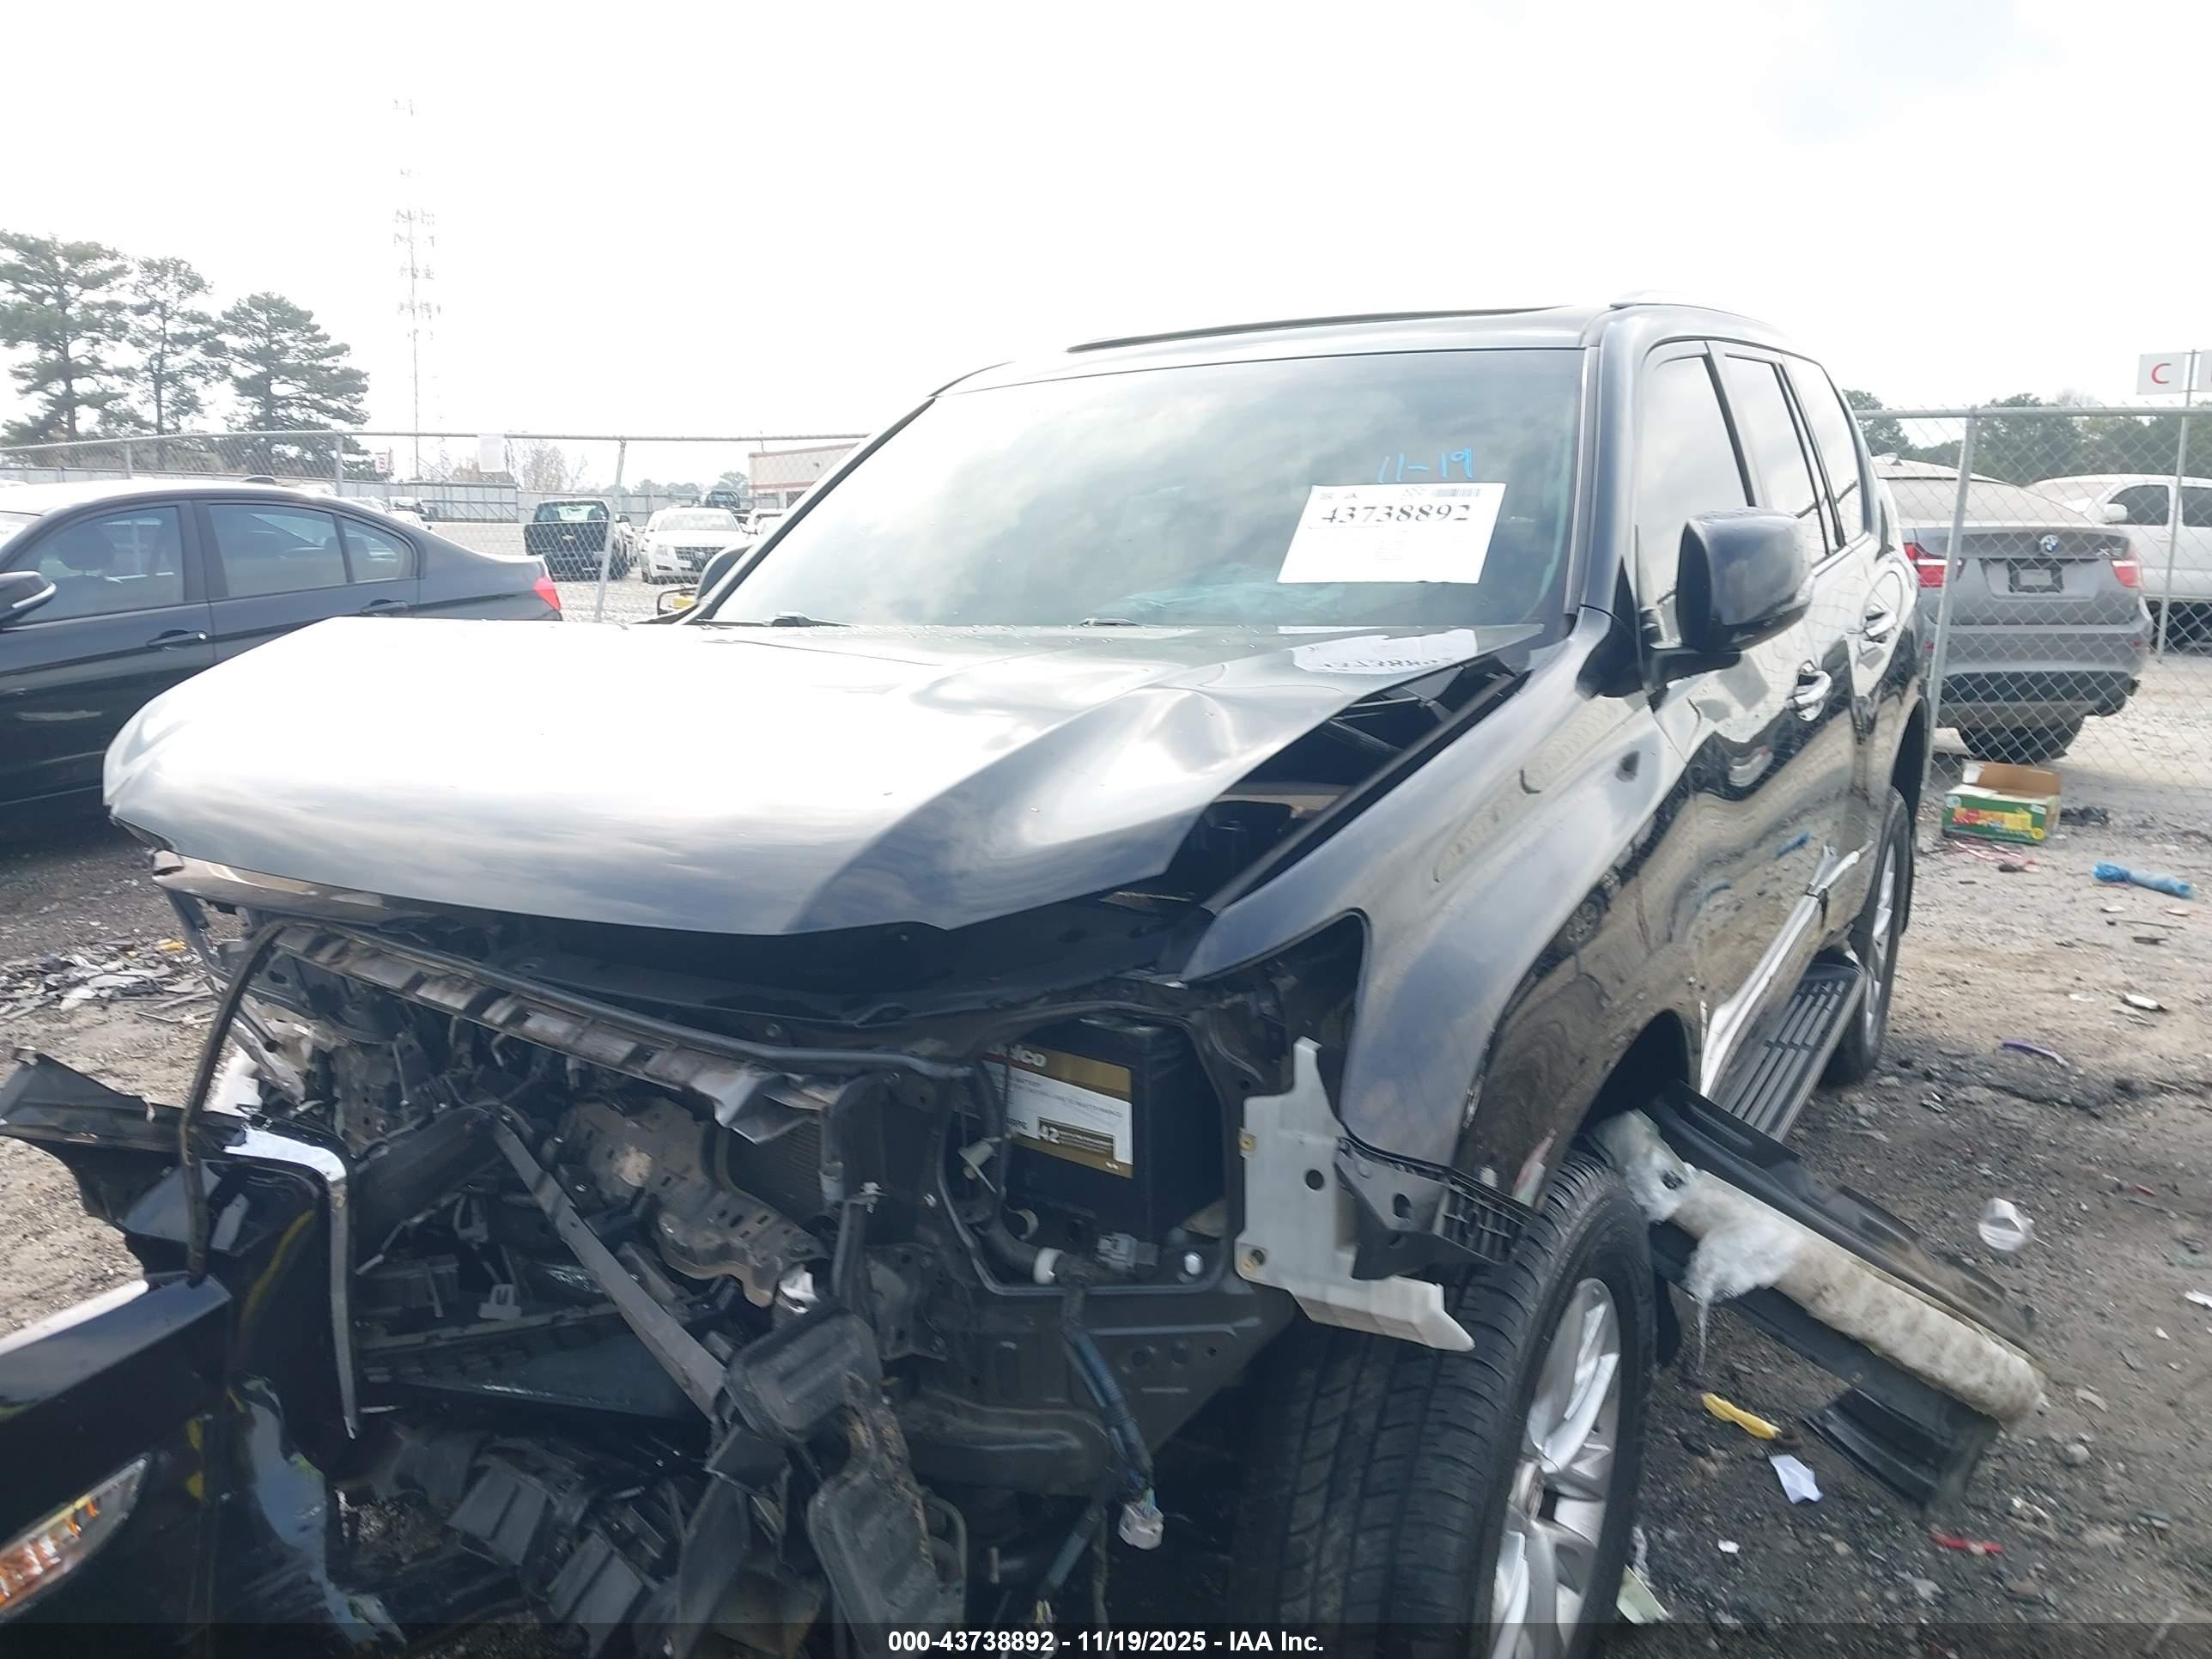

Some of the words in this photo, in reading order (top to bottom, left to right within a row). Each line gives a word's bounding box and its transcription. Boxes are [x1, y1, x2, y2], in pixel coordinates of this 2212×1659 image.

[2151, 362, 2171, 384] C
[1378, 448, 1473, 483] 11-19
[1321, 503, 1471, 524] 43738892
